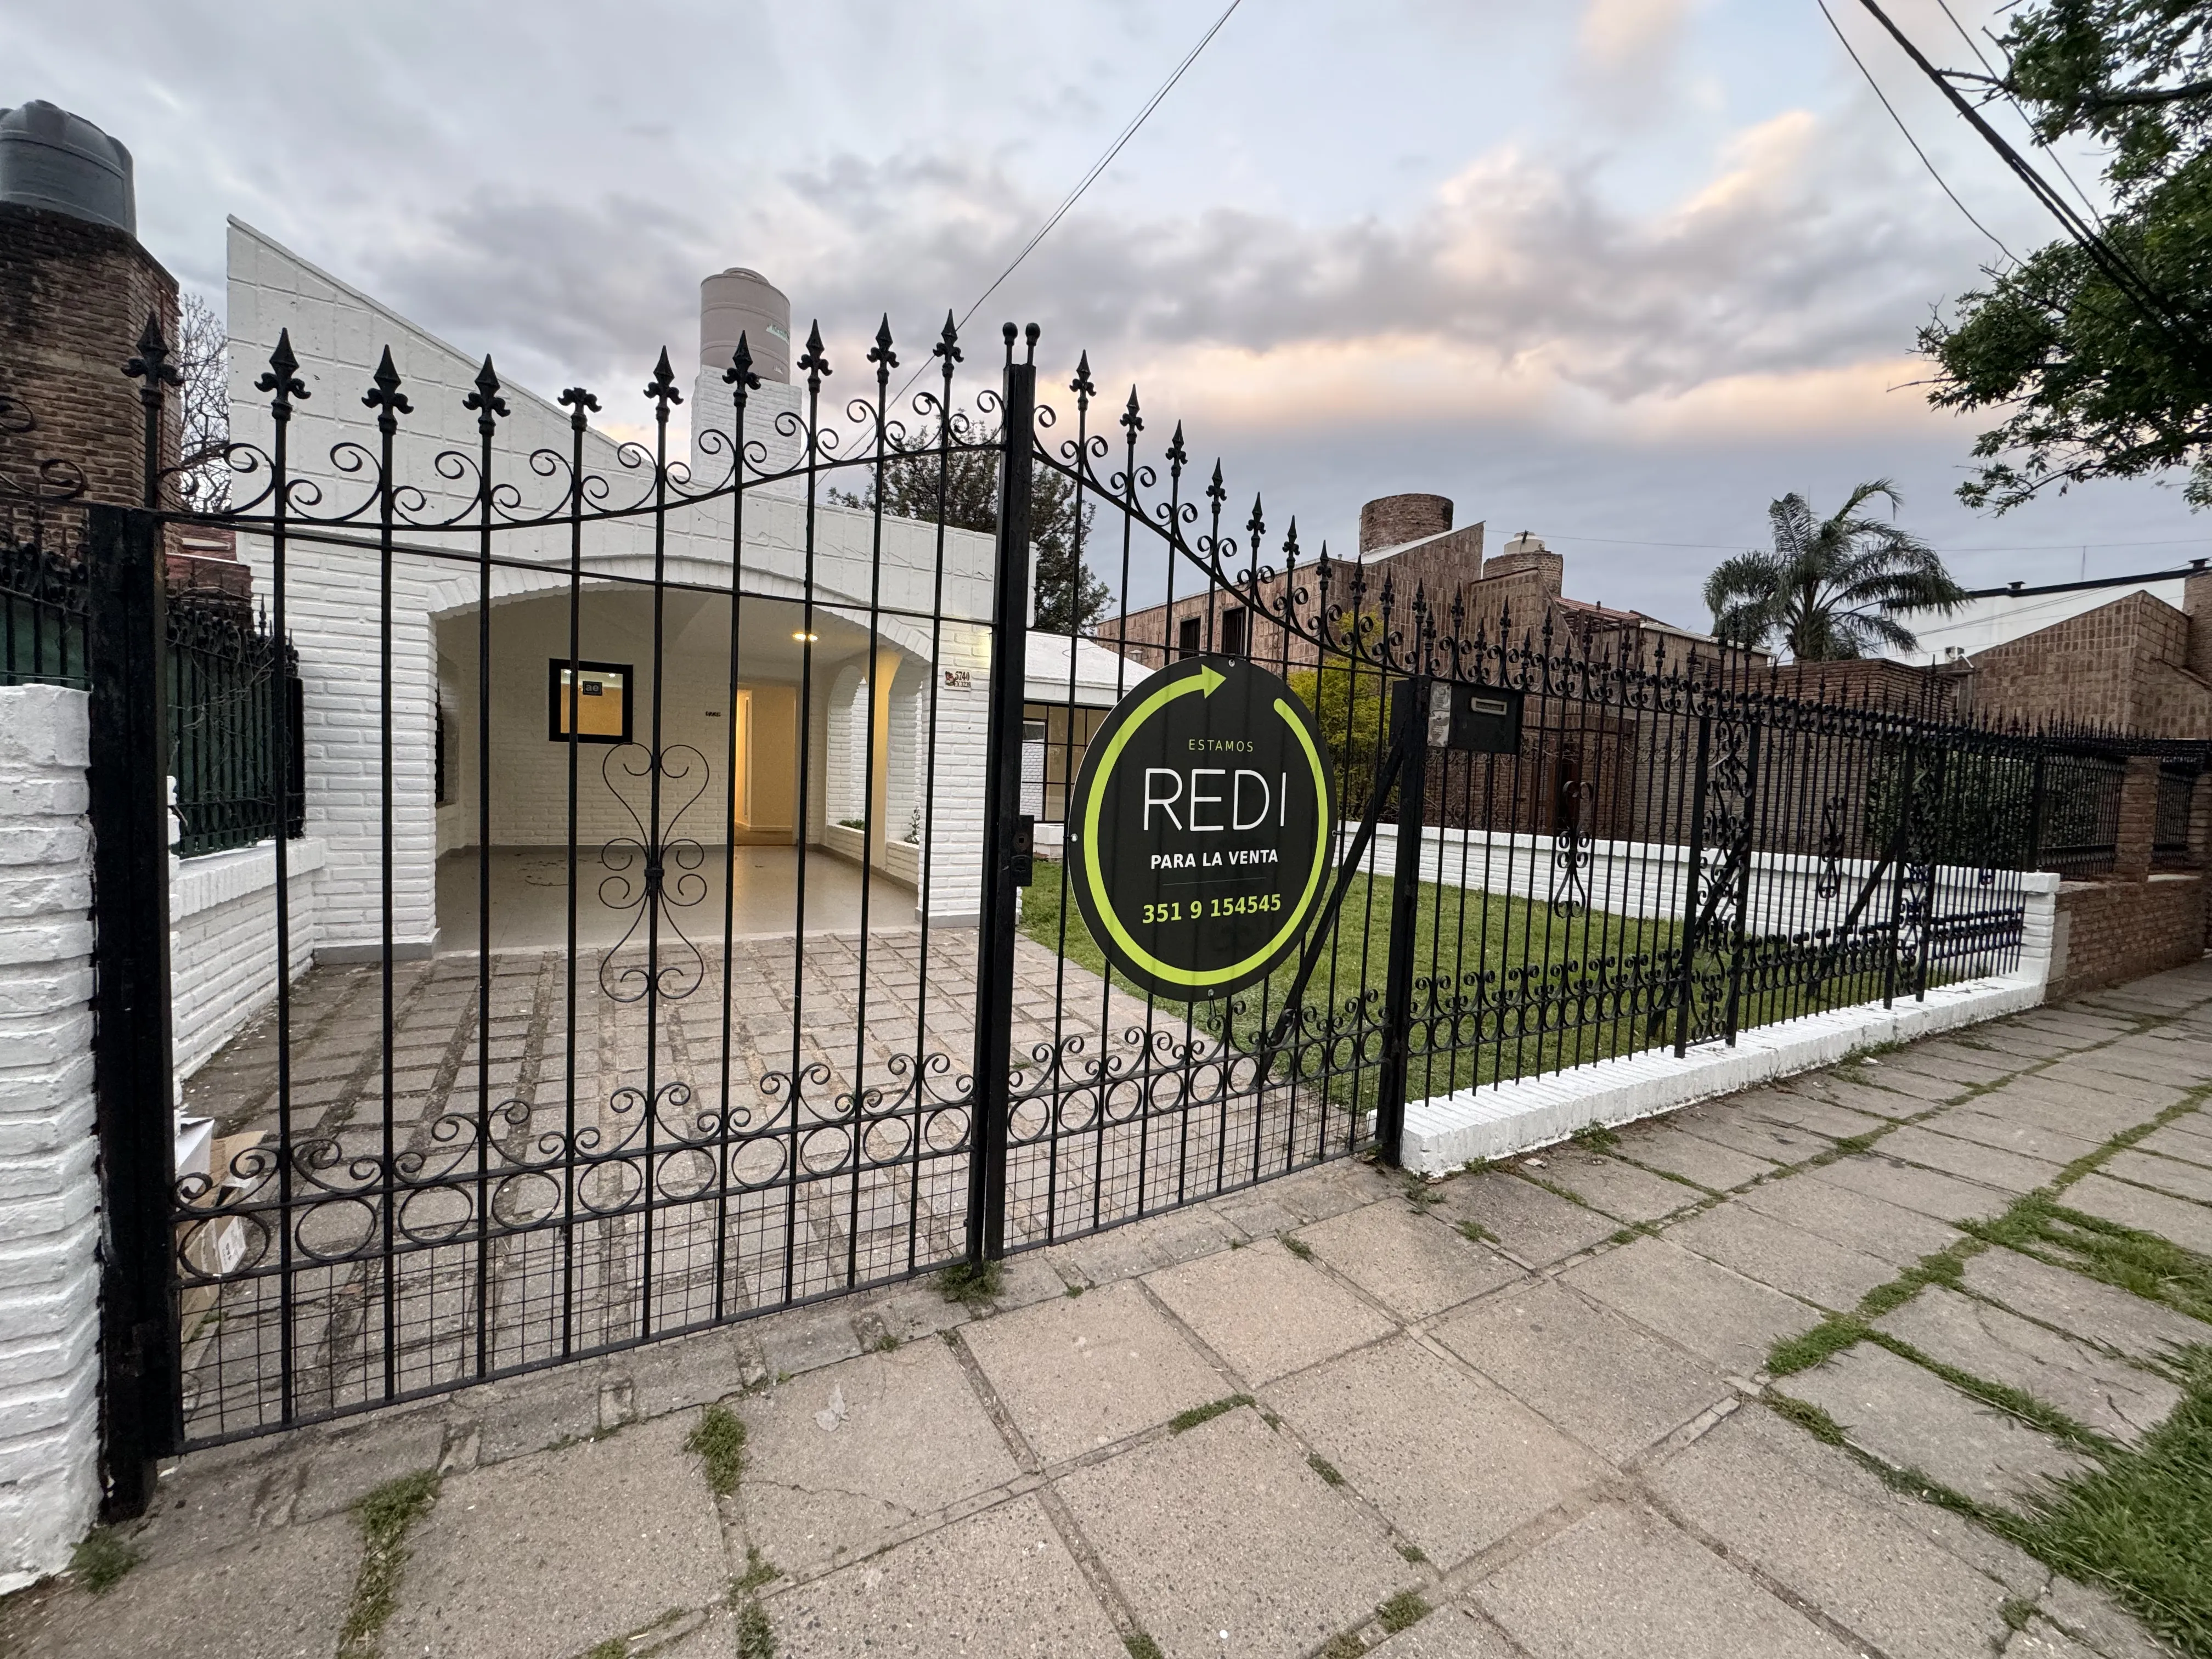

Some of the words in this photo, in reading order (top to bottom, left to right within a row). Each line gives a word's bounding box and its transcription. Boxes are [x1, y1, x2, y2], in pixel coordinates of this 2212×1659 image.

[955, 670, 970, 681] 5740
[1189, 740, 1253, 752] ESTAMOS
[1144, 768, 1286, 831] REDI
[1151, 853, 1196, 869] PARA
[1203, 852, 1222, 866] LA
[1229, 849, 1278, 865] VENTA
[1143, 902, 1181, 923] 351
[1190, 901, 1201, 918] 9
[1211, 894, 1280, 917] 154545
